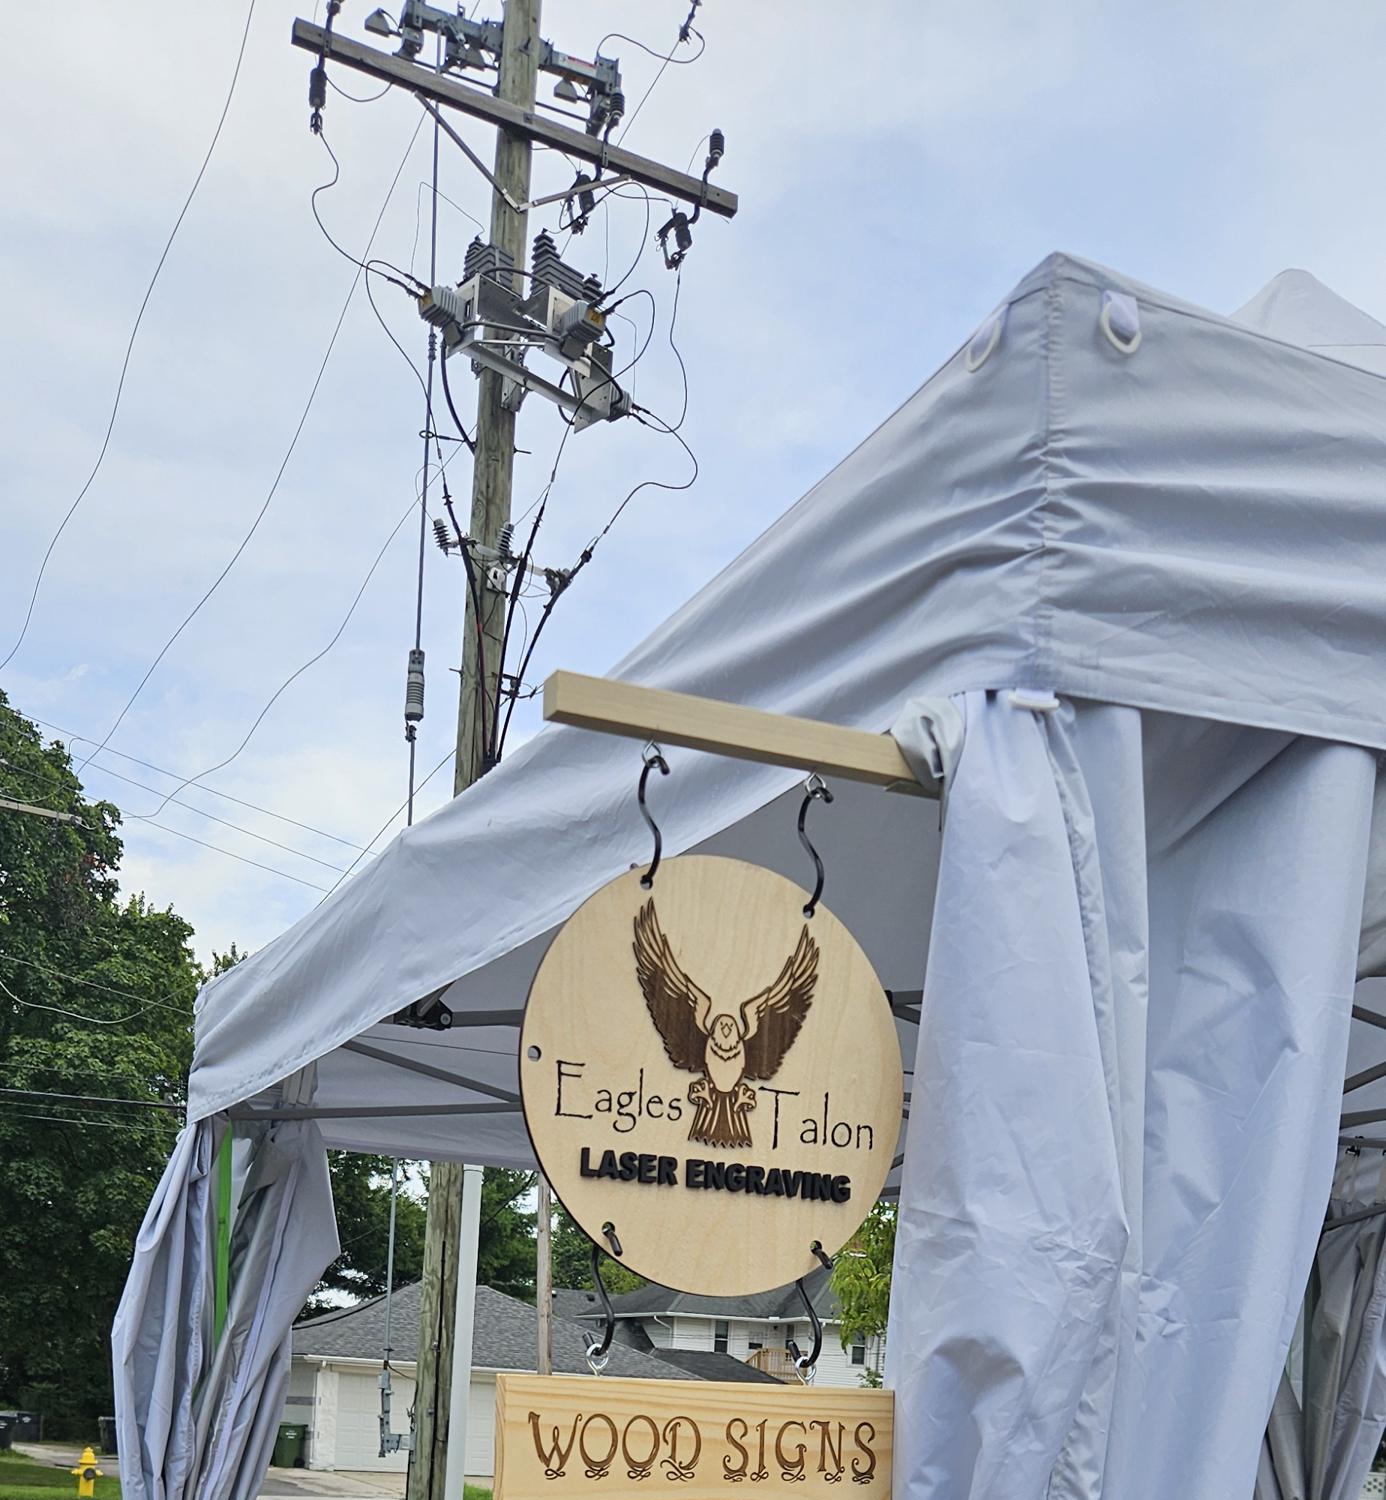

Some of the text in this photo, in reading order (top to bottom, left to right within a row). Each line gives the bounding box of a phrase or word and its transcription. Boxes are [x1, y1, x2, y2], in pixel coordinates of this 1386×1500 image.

[554, 1059, 874, 1150] Eagles Talon
[580, 1146, 852, 1204] LASER ENGRAVING
[528, 1411, 876, 1485] WOOD SIGNS
